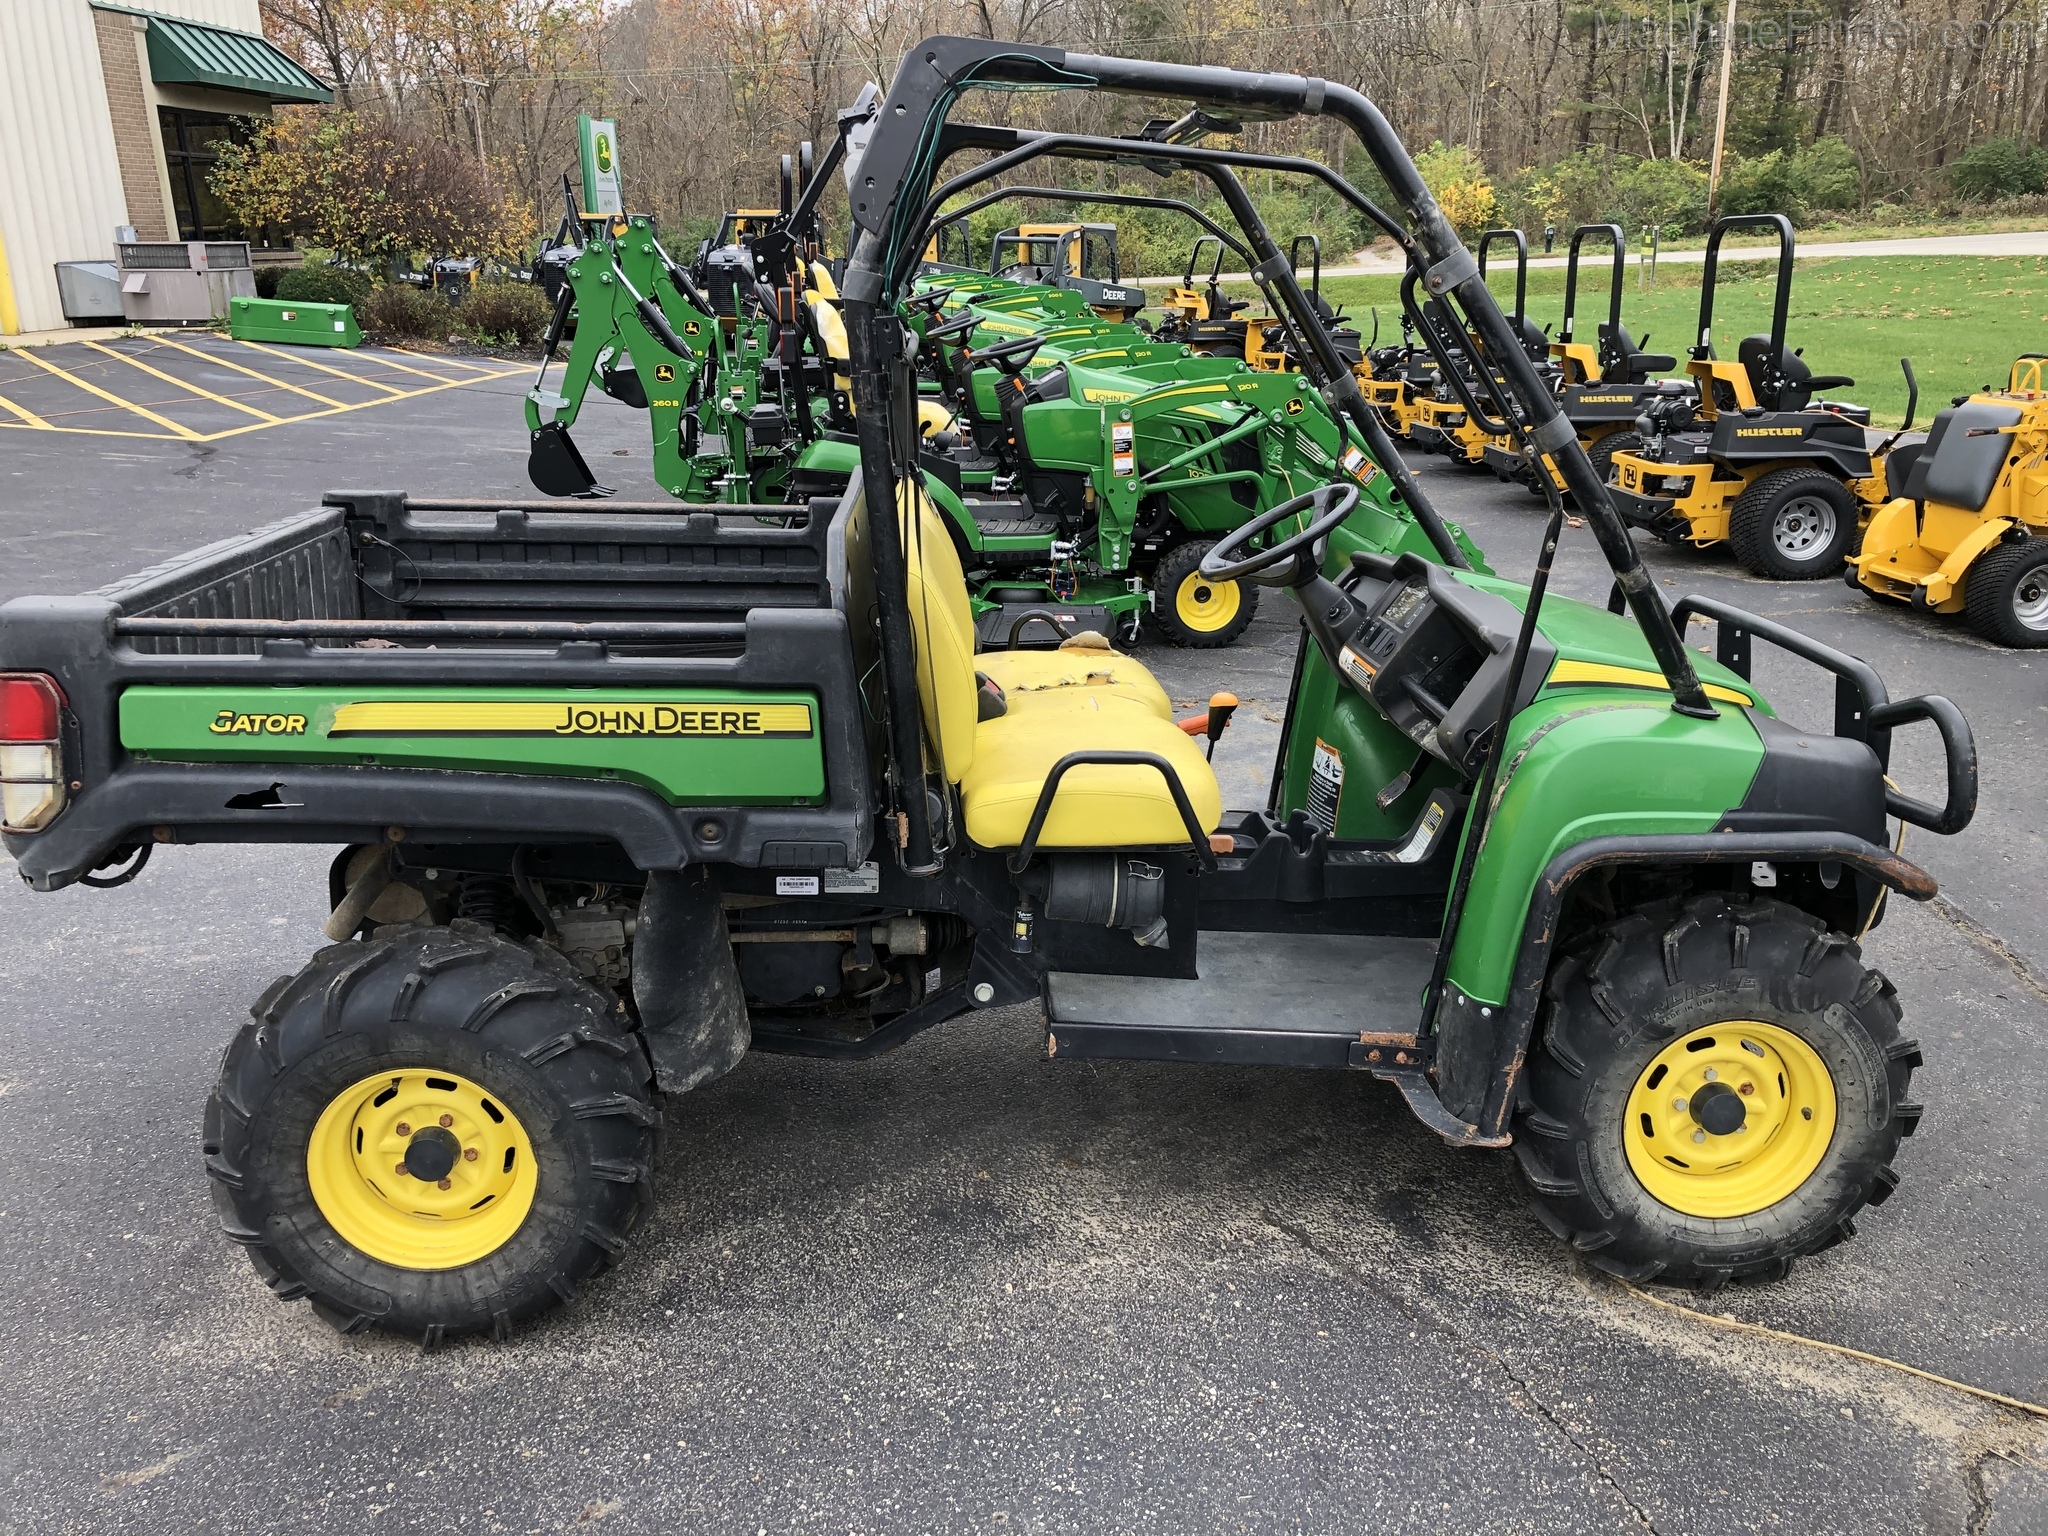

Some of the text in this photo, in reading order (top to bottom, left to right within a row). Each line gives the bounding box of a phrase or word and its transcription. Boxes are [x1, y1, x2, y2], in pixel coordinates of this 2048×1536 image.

[1102, 288, 1127, 301] DEERE
[1092, 392, 1121, 402] JOHN
[1579, 395, 1634, 403] HUSTLER
[1736, 427, 1803, 438] HUSTLER
[209, 710, 308, 736] GATOR
[555, 706, 763, 732] JOHN DEERE
